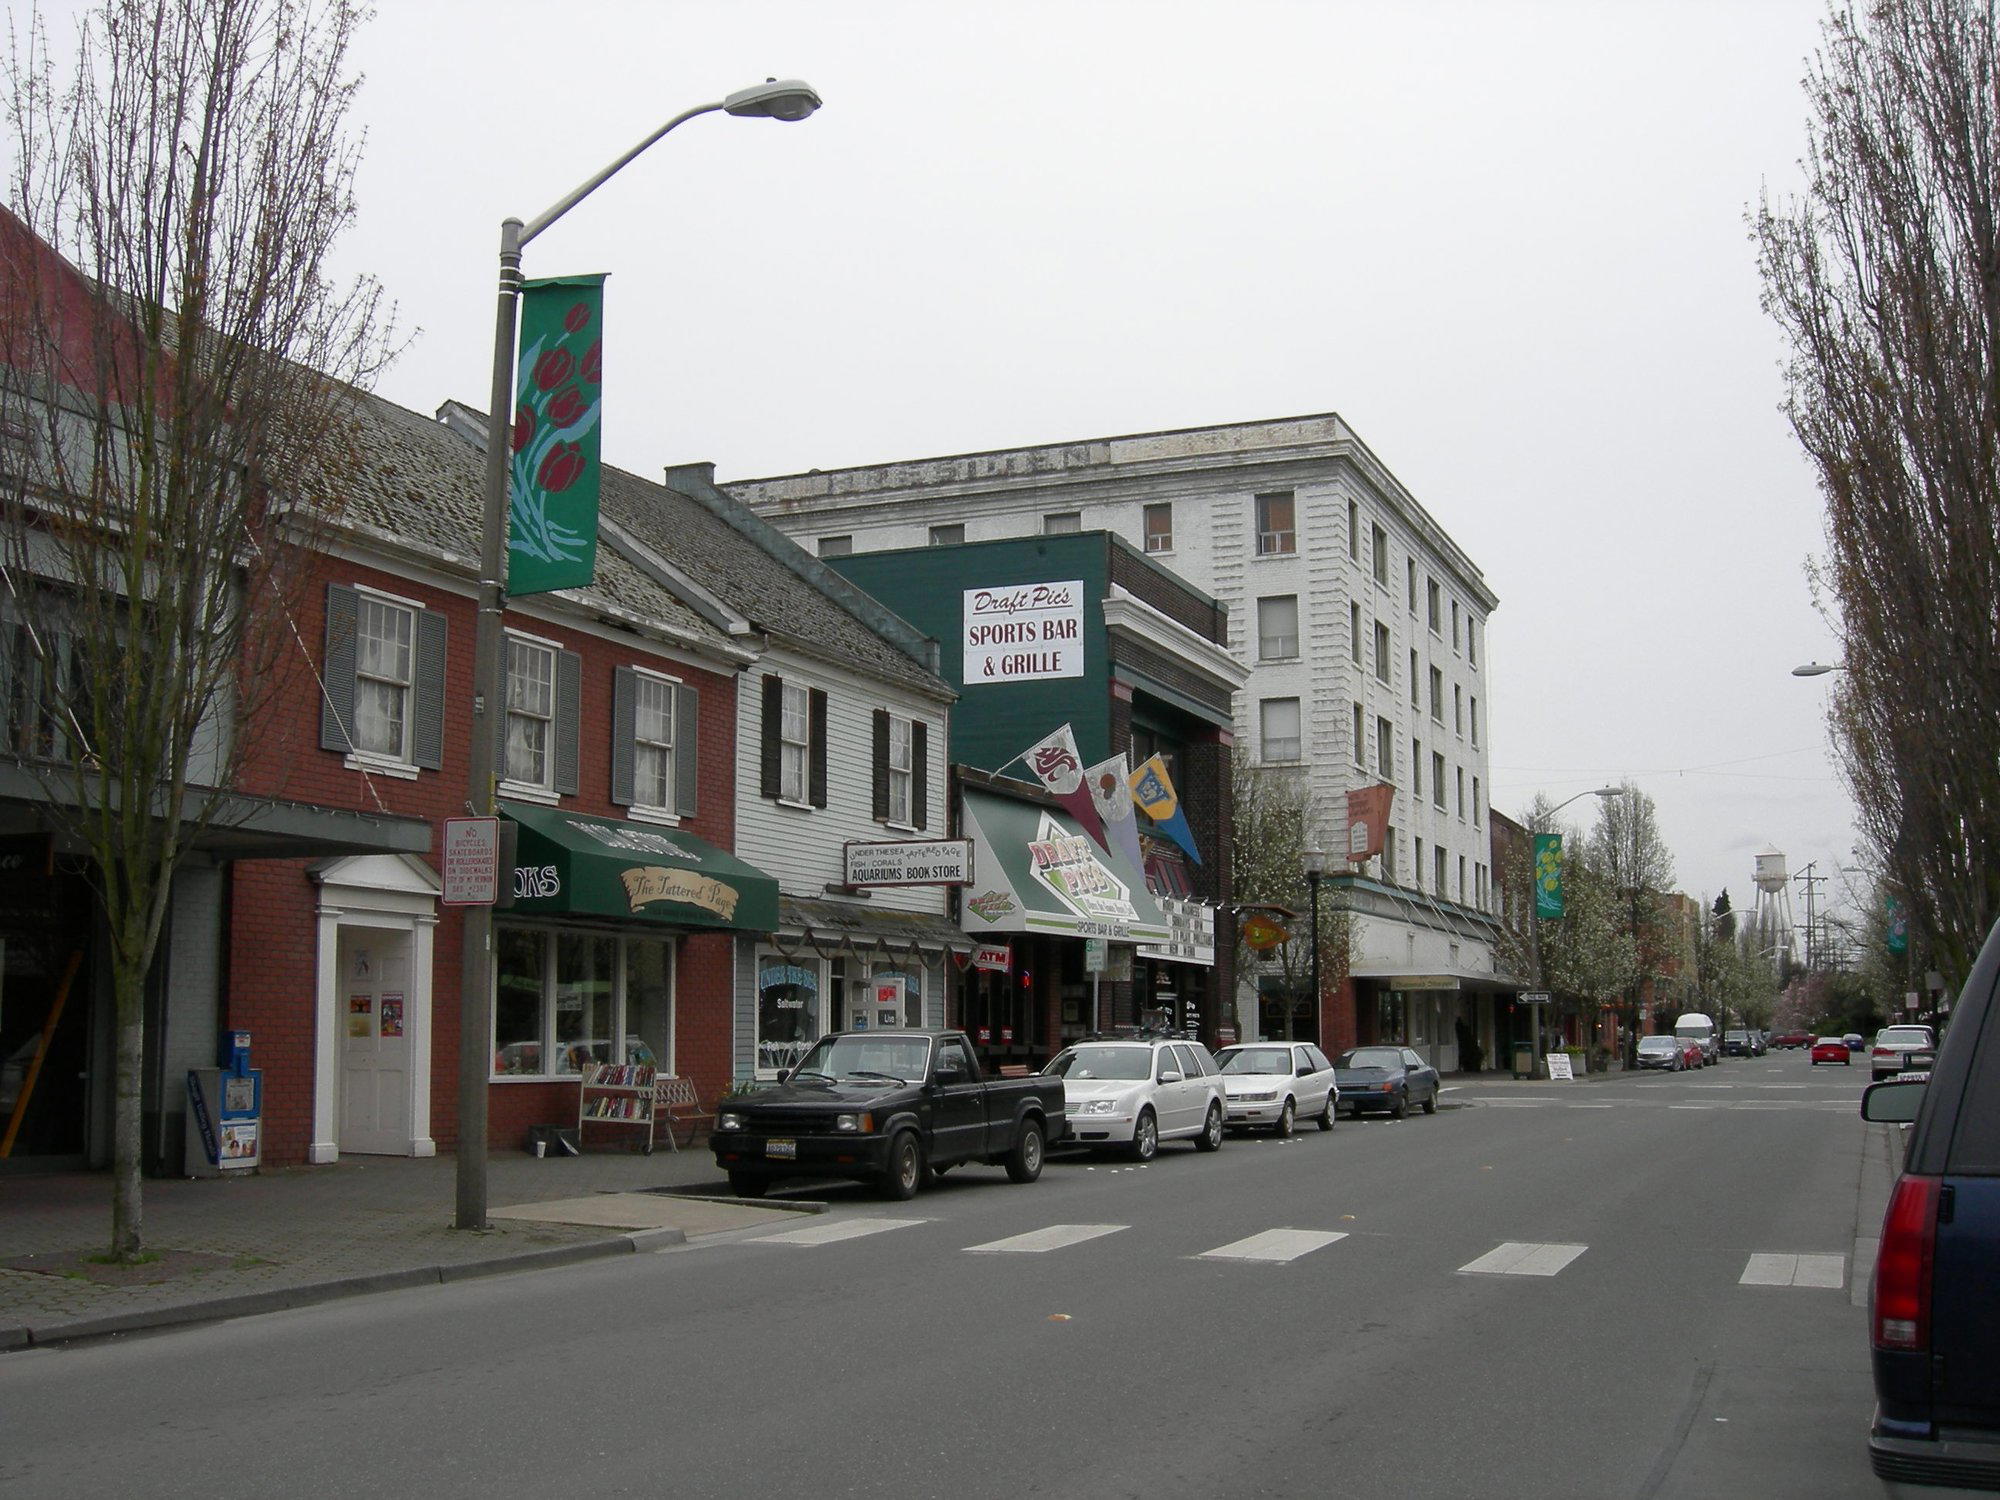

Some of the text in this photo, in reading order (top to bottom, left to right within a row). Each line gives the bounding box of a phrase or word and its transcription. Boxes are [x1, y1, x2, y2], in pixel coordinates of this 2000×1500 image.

[974, 586, 1071, 615] Draft Pic's
[969, 618, 1077, 647] SPORTS BAR
[983, 651, 1062, 677] & GRILLE
[465, 829, 477, 838] NO
[455, 839, 487, 847] BICYCLES
[449, 848, 493, 856] SKATEBOARDS
[849, 848, 874, 861] UNDER
[905, 846, 941, 860] TATTERED
[941, 845, 961, 858] PAGE
[851, 858, 903, 868] FISH CORALS
[852, 865, 961, 882] AQUARIUMS BOOK STORE
[633, 875, 731, 912] The Tattered Page
[1077, 920, 1097, 935] SPORTS
[1097, 923, 1108, 935] BAR
[1113, 924, 1130, 938] GRILLE
[979, 951, 1006, 964] ATM
[777, 998, 804, 1009] Saltwater
